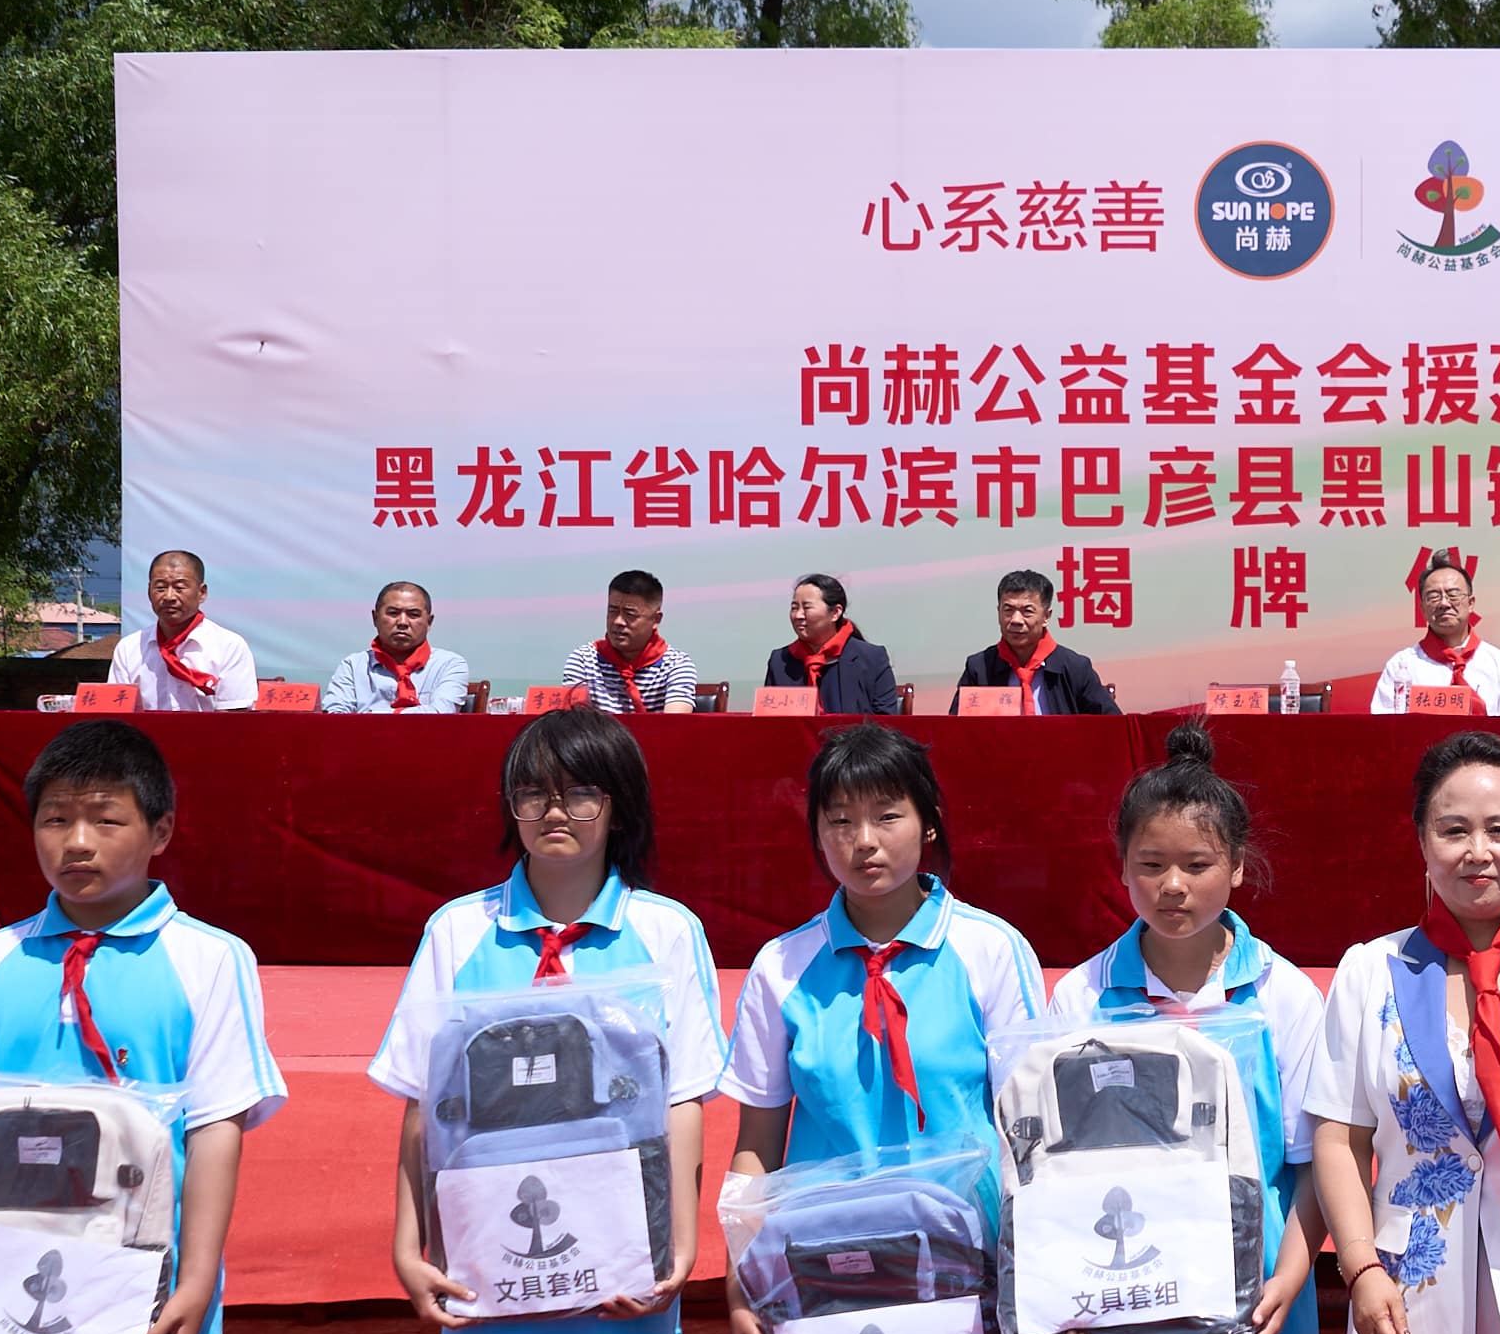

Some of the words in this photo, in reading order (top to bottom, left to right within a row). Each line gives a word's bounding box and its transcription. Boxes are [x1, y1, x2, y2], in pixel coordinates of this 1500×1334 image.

[863, 181, 1163, 251] 心系慈善
[1236, 225, 1291, 251] 尚赫
[493, 1268, 599, 1304] 文具套组
[1072, 1281, 1180, 1318] 文具套组
